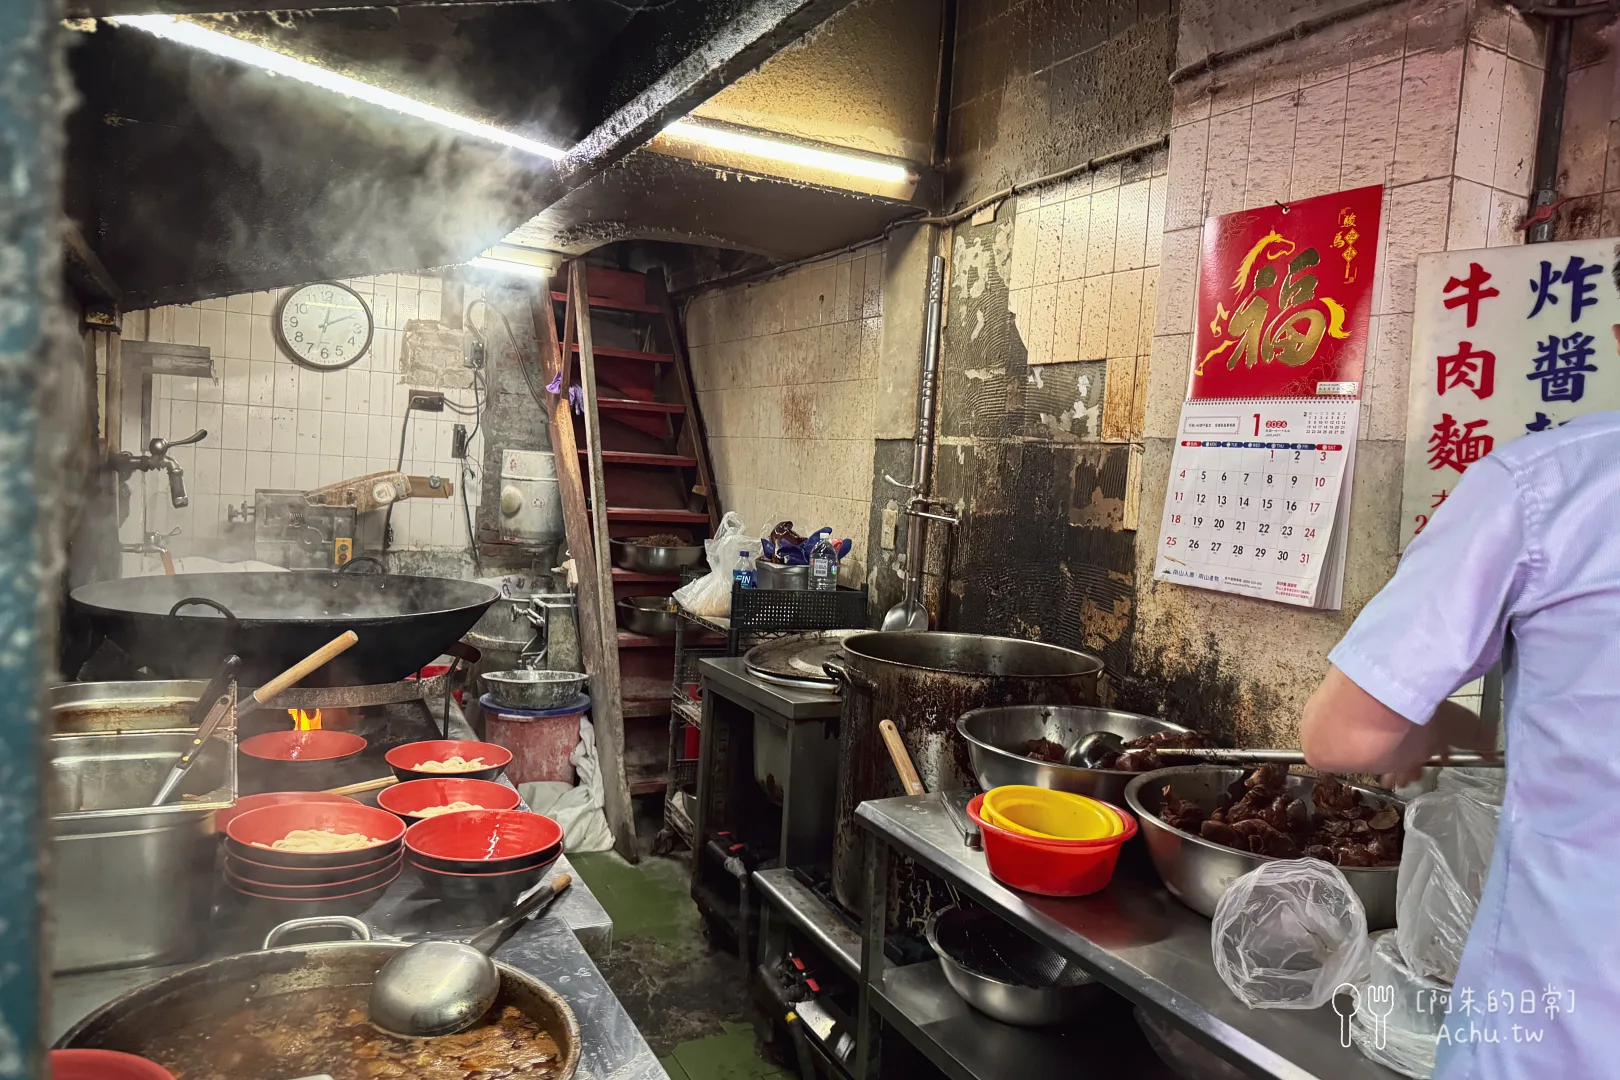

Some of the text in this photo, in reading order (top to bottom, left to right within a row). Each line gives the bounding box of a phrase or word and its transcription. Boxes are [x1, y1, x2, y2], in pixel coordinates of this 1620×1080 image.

[308, 293, 316, 302] 11
[321, 290, 333, 301] 12
[295, 303, 308, 314] 10
[1227, 248, 1326, 371] 福
[290, 316, 298, 327] 9
[353, 323, 361, 334] 3
[295, 331, 303, 342] 8
[347, 336, 355, 346] 4
[307, 342, 314, 353] 7
[321, 347, 329, 359] 6
[335, 345, 343, 356] 5
[1427, 262, 1500, 474] 牛肉麵
[1252, 413, 1260, 436] 1
[1265, 420, 1288, 428] 2026
[1270, 450, 1326, 461] 1 2 3
[1180, 470, 1325, 487] 4 5 6 7 8 9 10
[1176, 492, 1320, 512] 11 12 13 14 15 16 17
[1172, 515, 1315, 537] 18 19 20 21 22 23 24
[1167, 537, 1309, 563] 25 26 27 28 29 30 31
